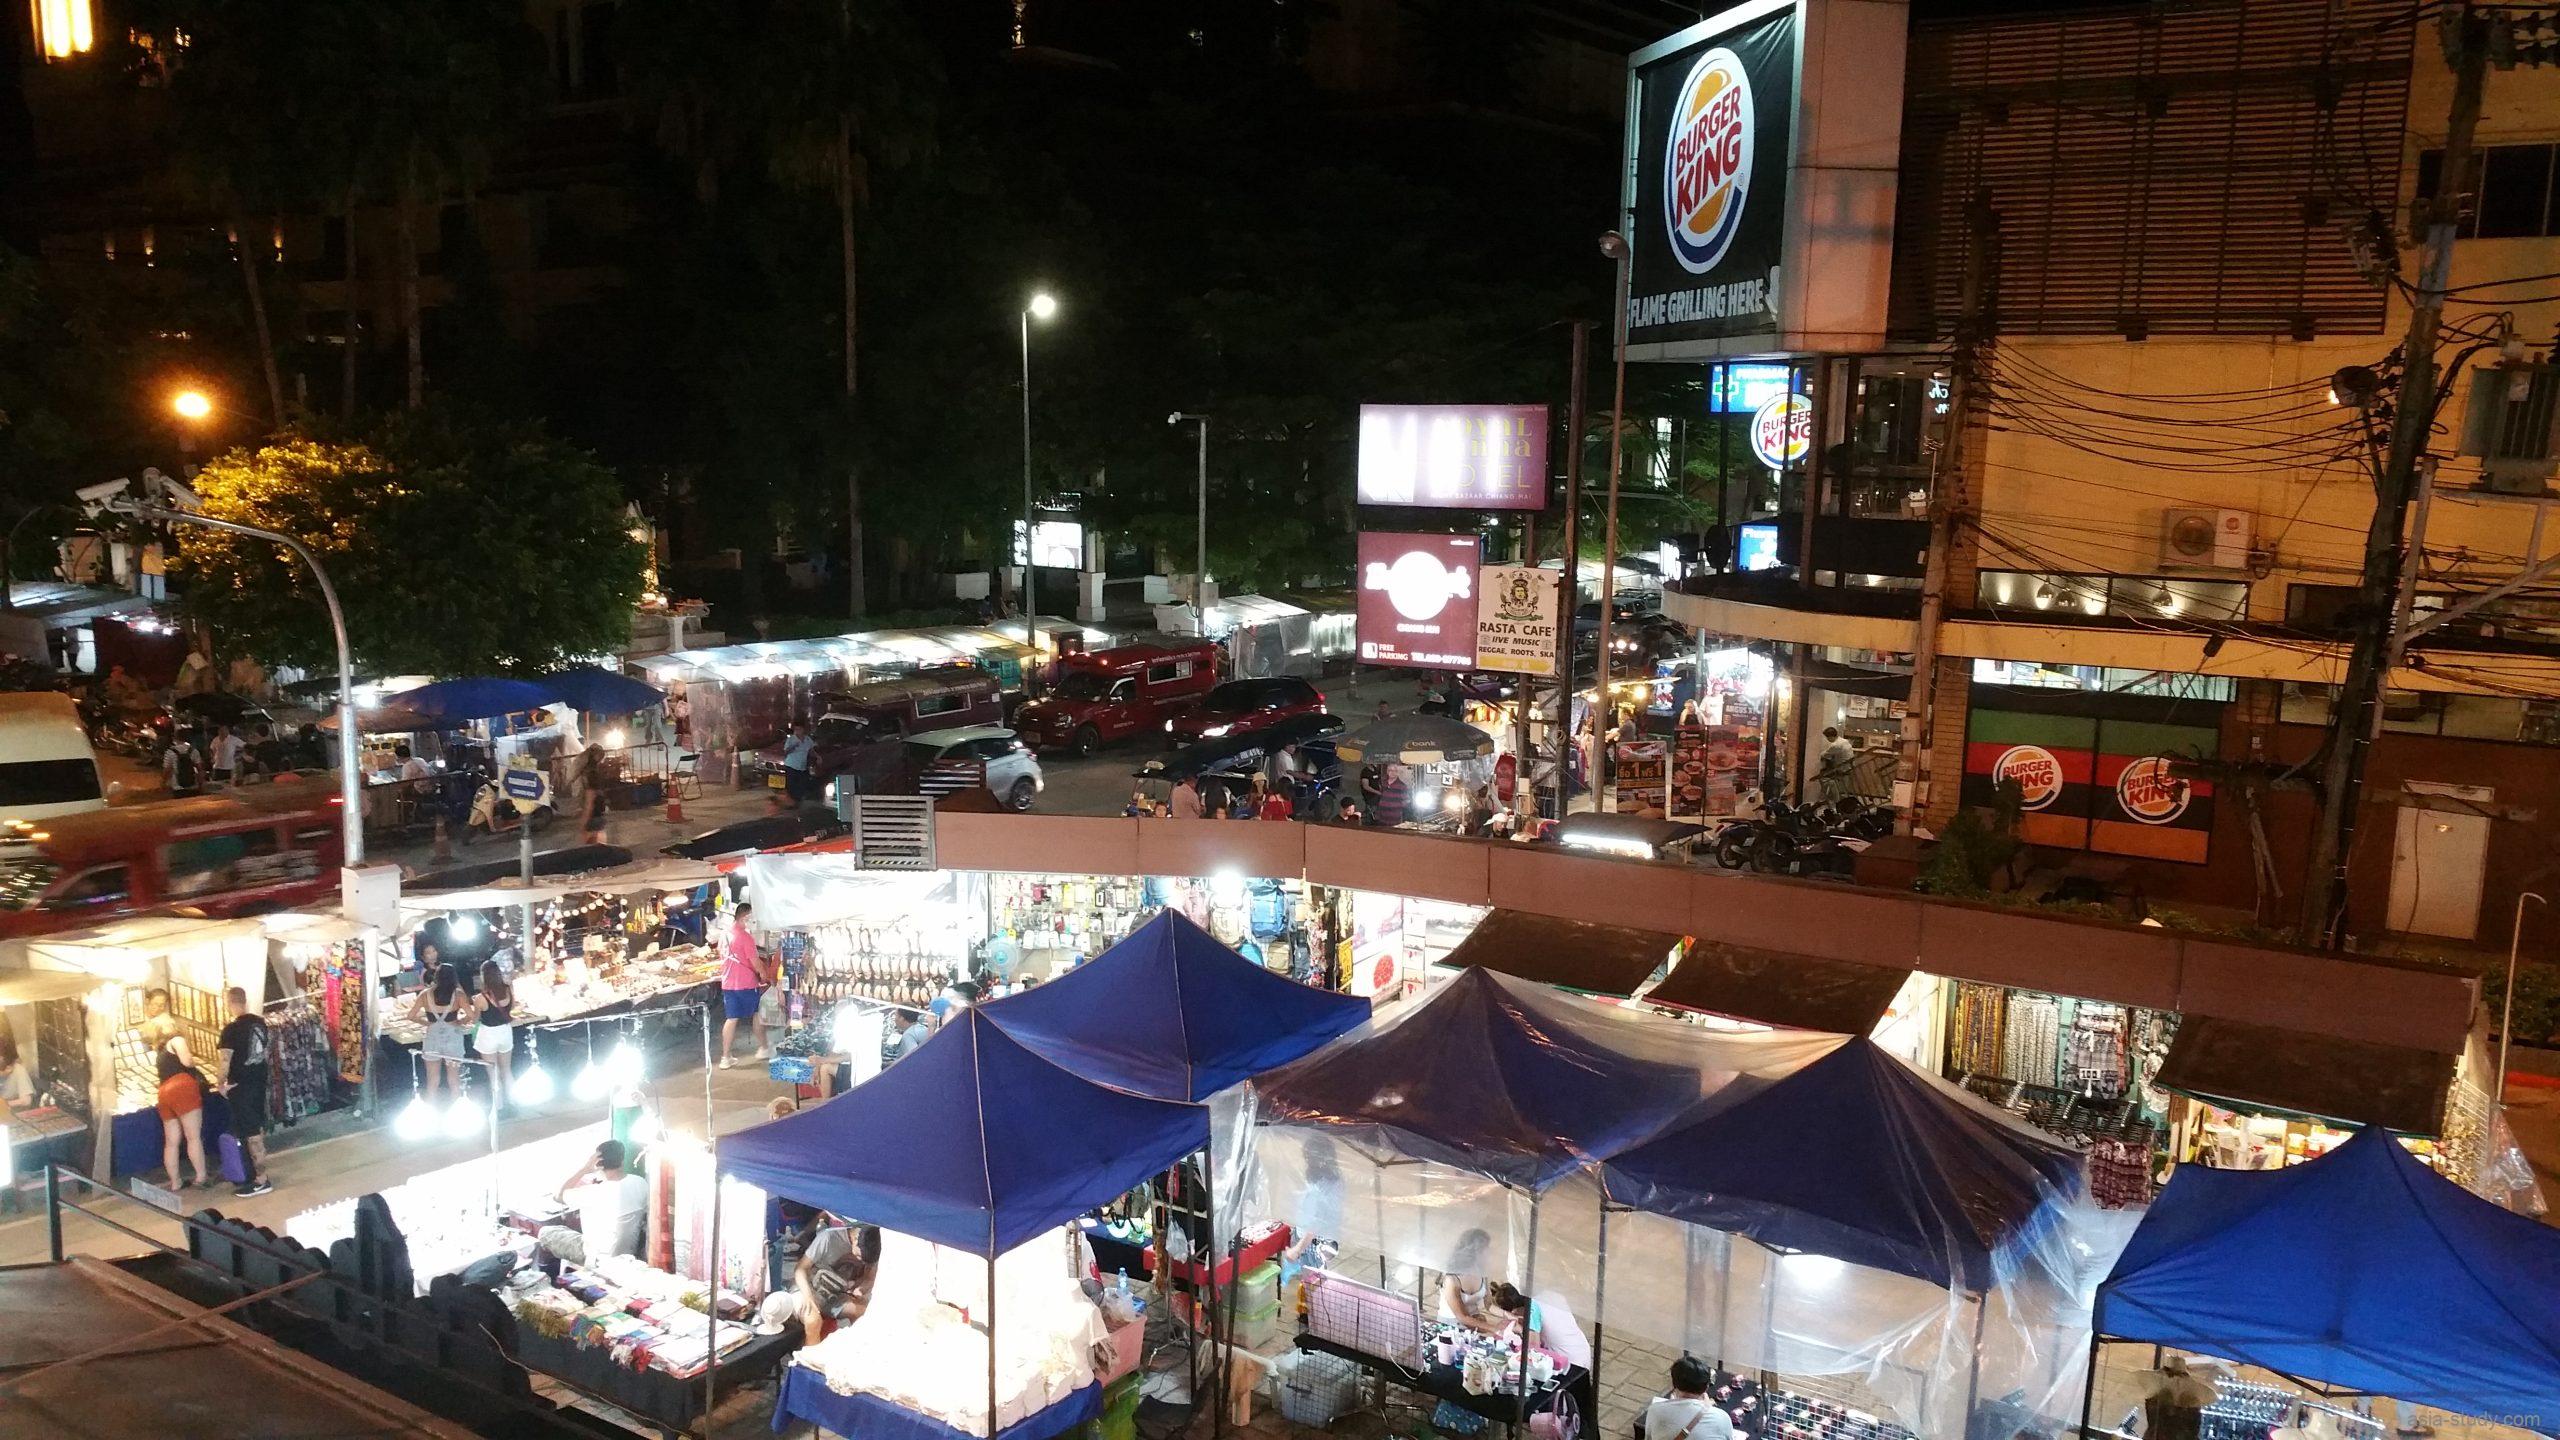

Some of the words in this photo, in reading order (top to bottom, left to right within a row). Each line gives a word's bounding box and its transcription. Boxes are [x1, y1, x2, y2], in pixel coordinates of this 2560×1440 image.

[1676, 86, 1741, 170] BURGER
[1676, 121, 1742, 230] KING
[1631, 294, 1667, 328] FLAME
[1668, 285, 1725, 323] GRILLING
[1727, 279, 1764, 317] HERE
[1480, 622, 1516, 634] RASTA
[1379, 643, 1394, 651] FREE
[1512, 638, 1540, 646] MUSIC
[1379, 651, 1408, 660] PARKING
[1478, 646, 1507, 655] REGGAE,
[1510, 648, 1536, 657] ROOTS,
[1540, 650, 1555, 658] SKA
[2003, 761, 2052, 776] BURGER
